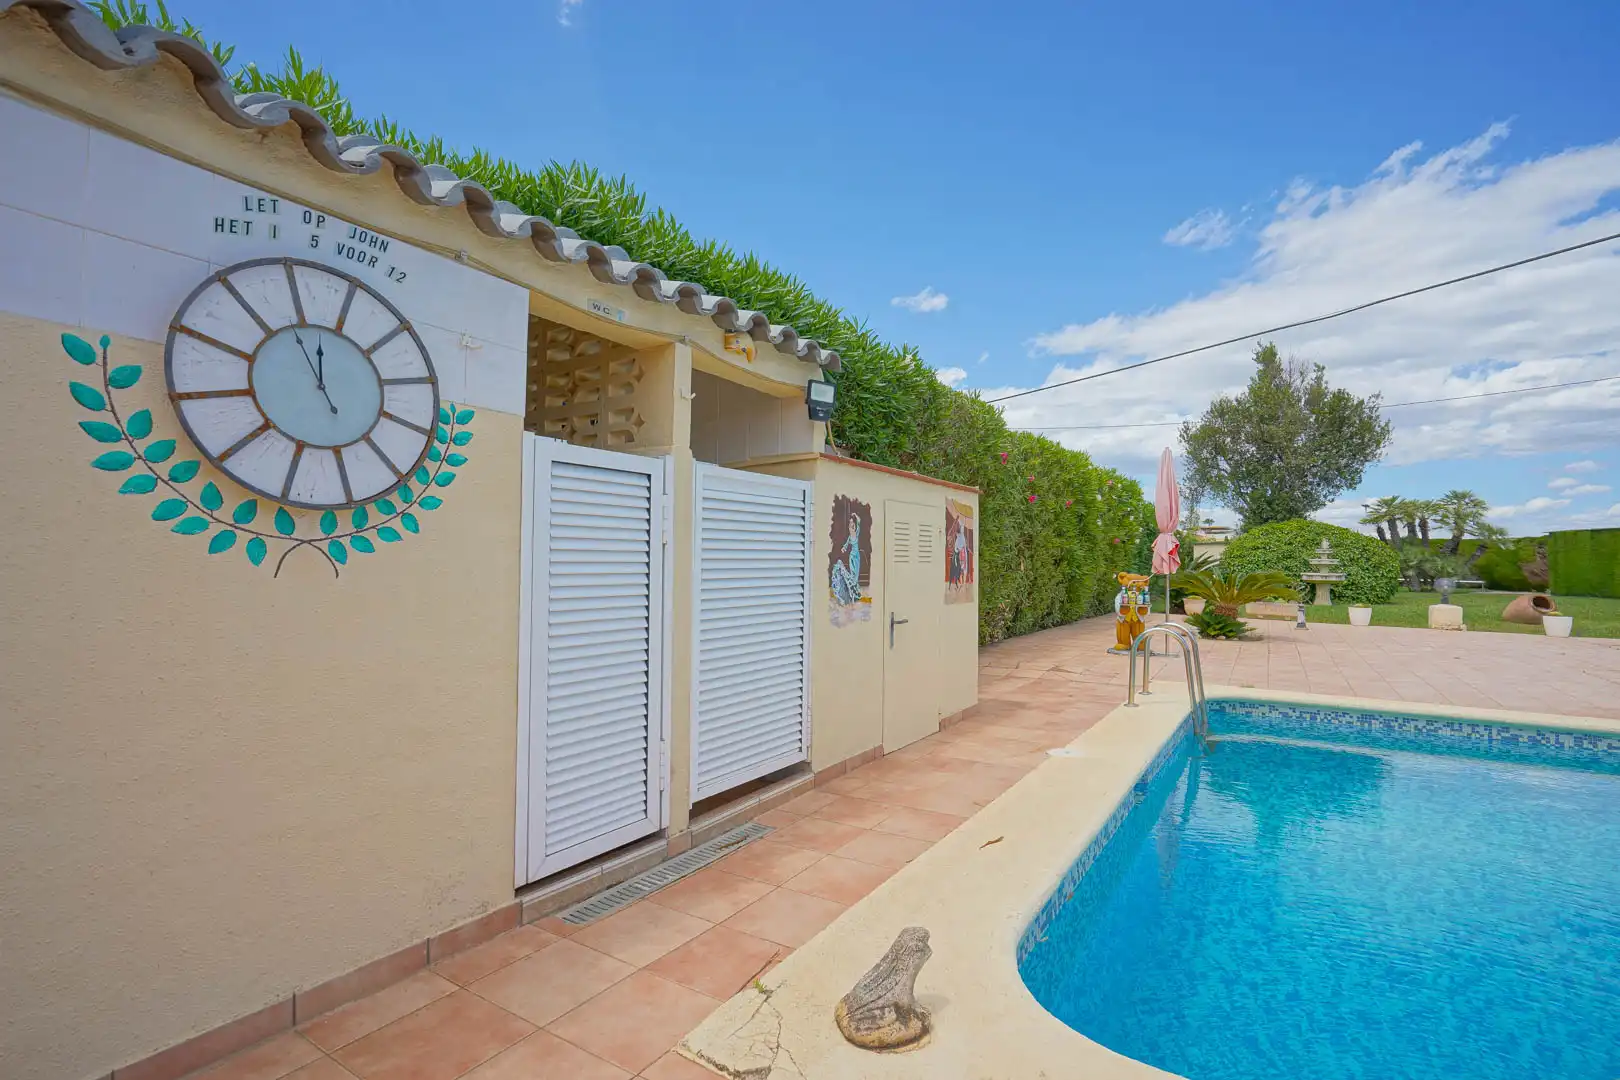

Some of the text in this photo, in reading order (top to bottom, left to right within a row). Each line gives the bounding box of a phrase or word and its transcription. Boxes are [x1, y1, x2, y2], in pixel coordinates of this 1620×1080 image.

[214, 217, 252, 236] HET
[310, 235, 320, 248] 5
[336, 242, 379, 268] VOOR
[388, 266, 407, 284] 12
[244, 196, 390, 253] LET OP JOHN
